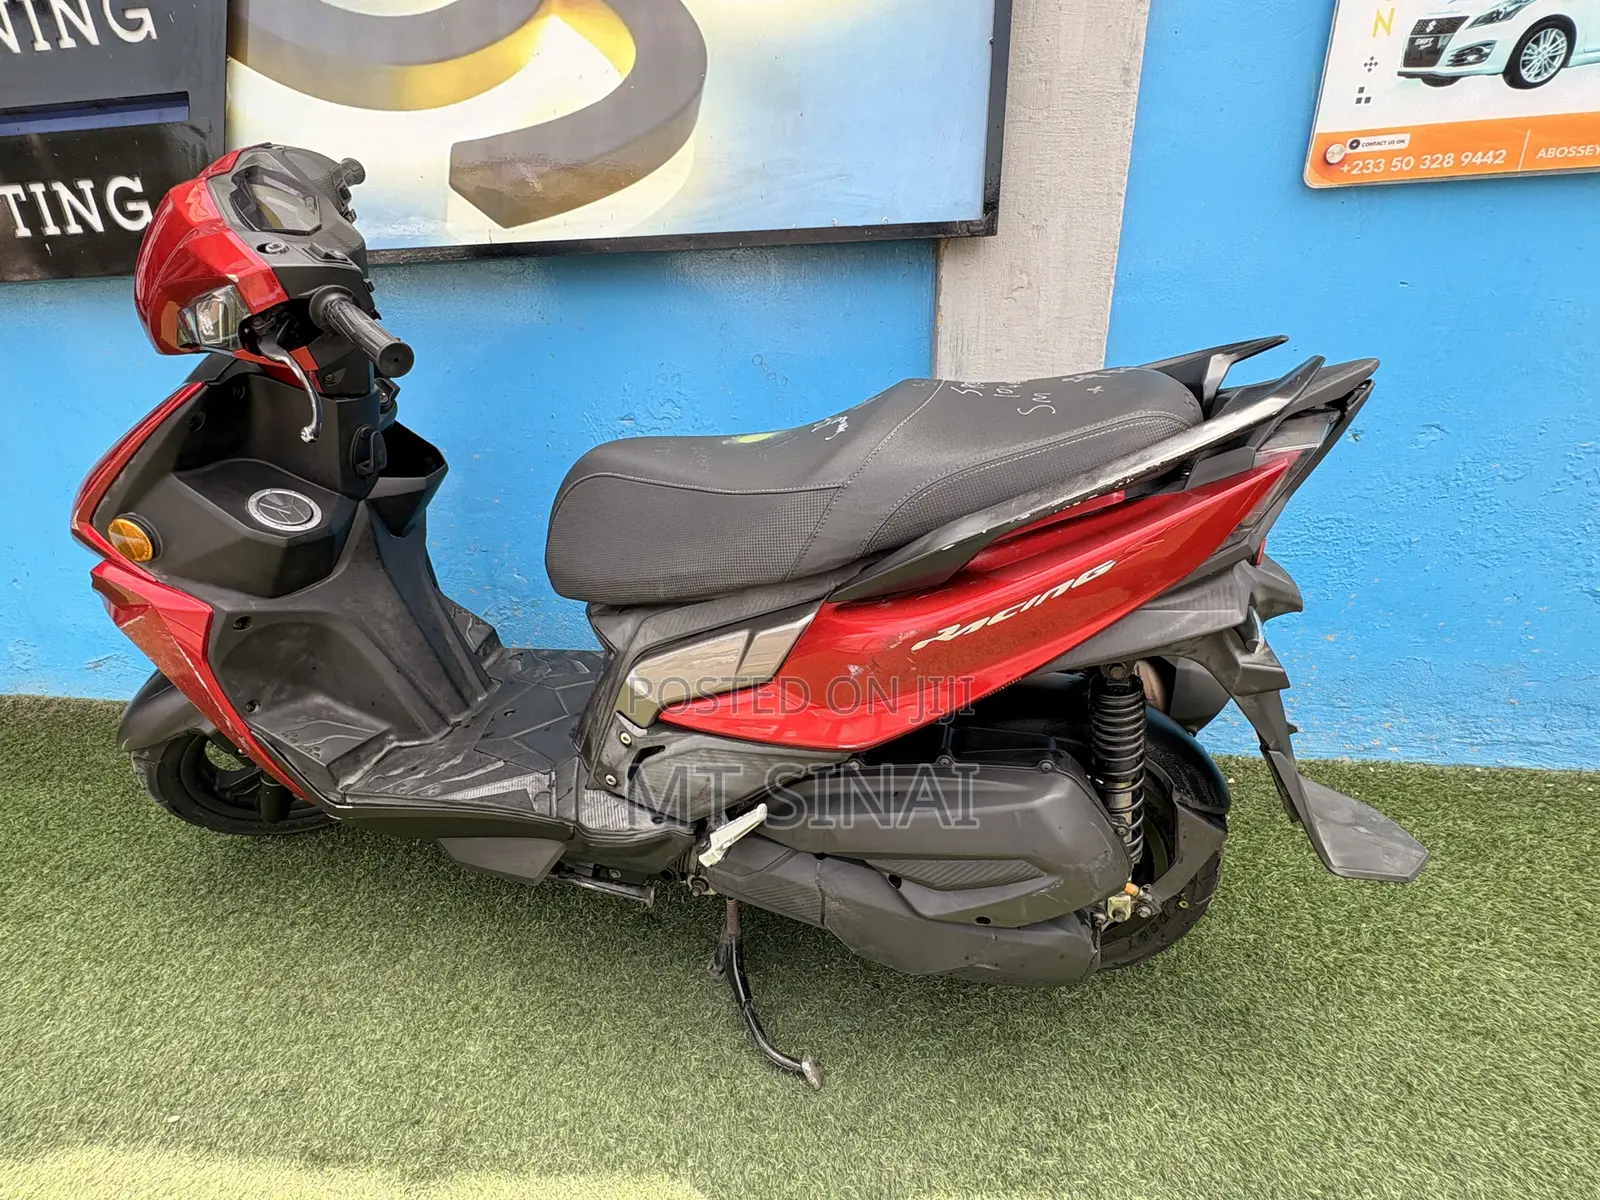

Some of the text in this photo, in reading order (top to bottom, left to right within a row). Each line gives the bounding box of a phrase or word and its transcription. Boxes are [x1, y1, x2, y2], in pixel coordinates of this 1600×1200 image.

[1340, 149, 1507, 175] +233 50 328 9442
